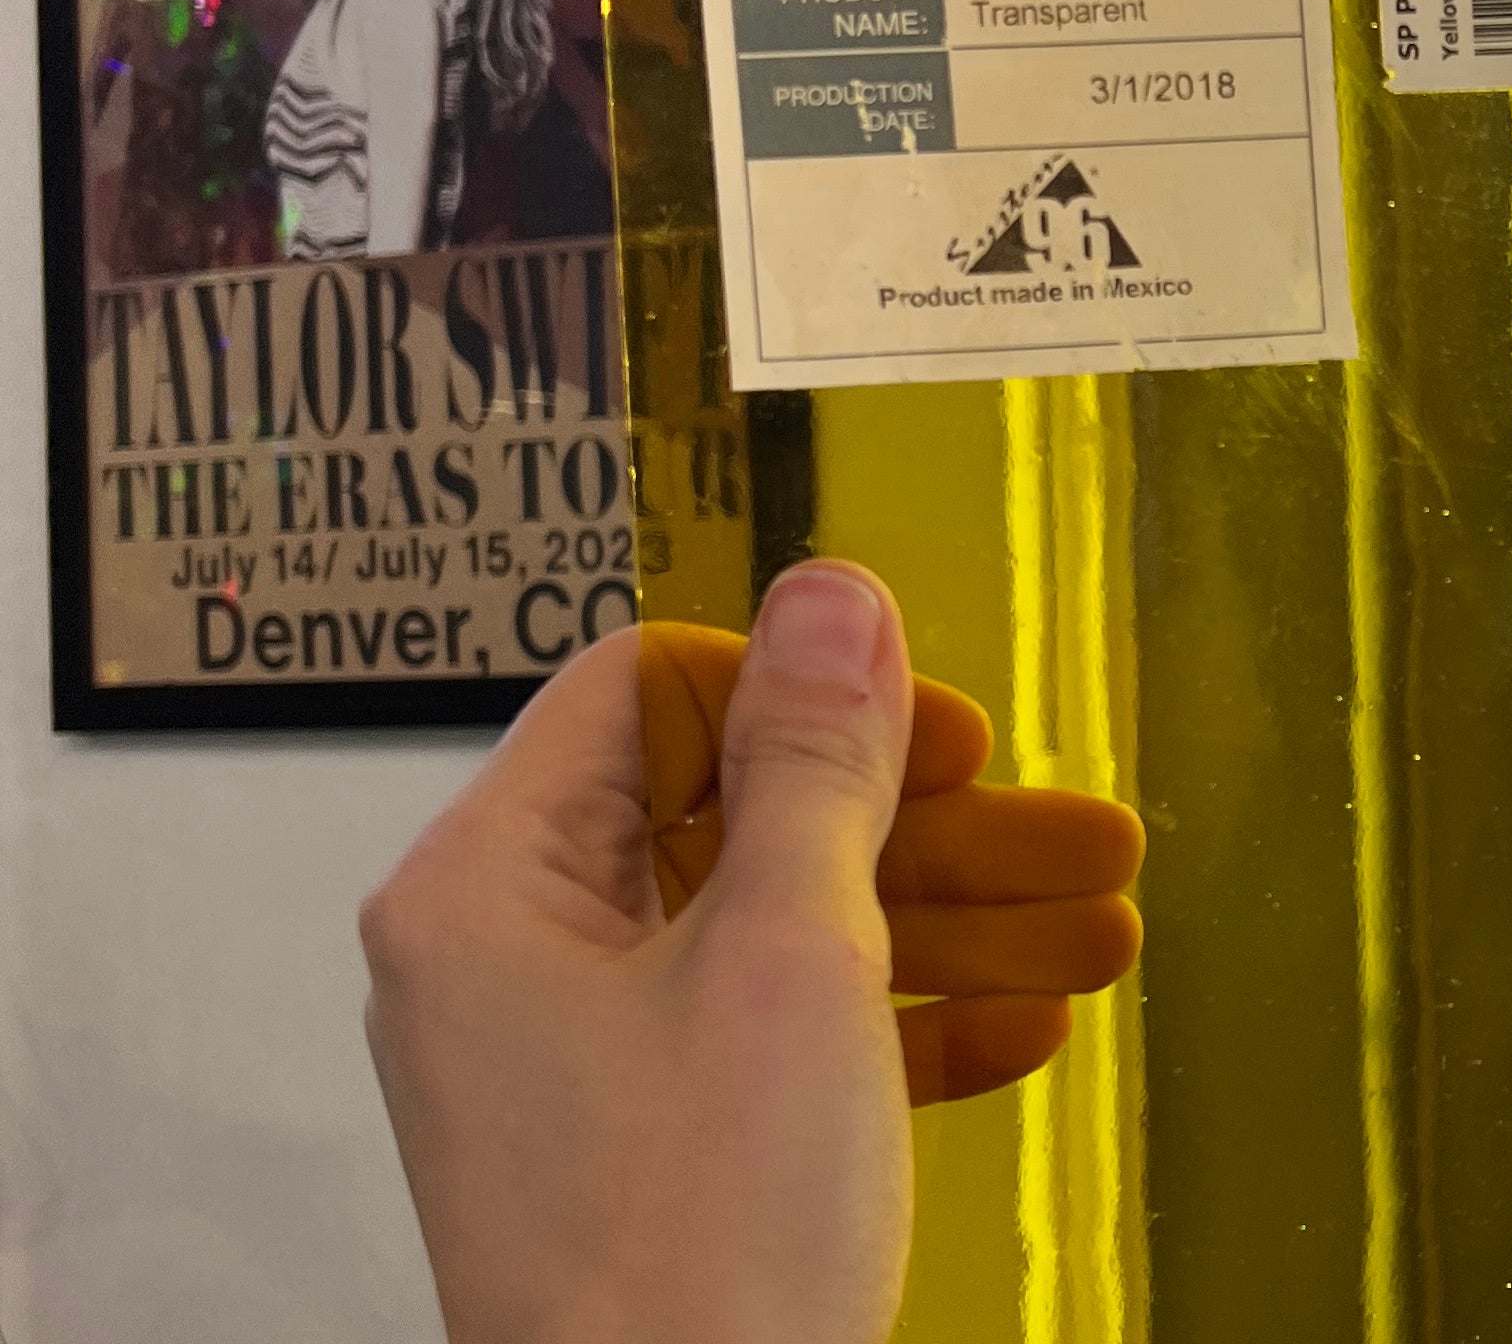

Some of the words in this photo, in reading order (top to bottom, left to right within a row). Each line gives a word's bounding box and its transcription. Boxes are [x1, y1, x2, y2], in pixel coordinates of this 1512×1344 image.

[832, 10, 930, 38] NAME:
[1398, 25, 1420, 61] SP
[774, 81, 934, 107] PRODUCTION
[1088, 70, 1237, 107] 3/1/2018
[867, 109, 936, 133] DATE:
[879, 286, 984, 309] Product
[991, 282, 1063, 305] made
[1071, 280, 1095, 301] in
[1104, 277, 1193, 299] Mexico
[101, 262, 420, 450] TAYLOR
[103, 456, 251, 543] THE
[275, 443, 480, 536] ERAS
[171, 547, 261, 591] July
[355, 535, 449, 584] July
[467, 531, 528, 579] 15,
[195, 596, 492, 678] Denver,
